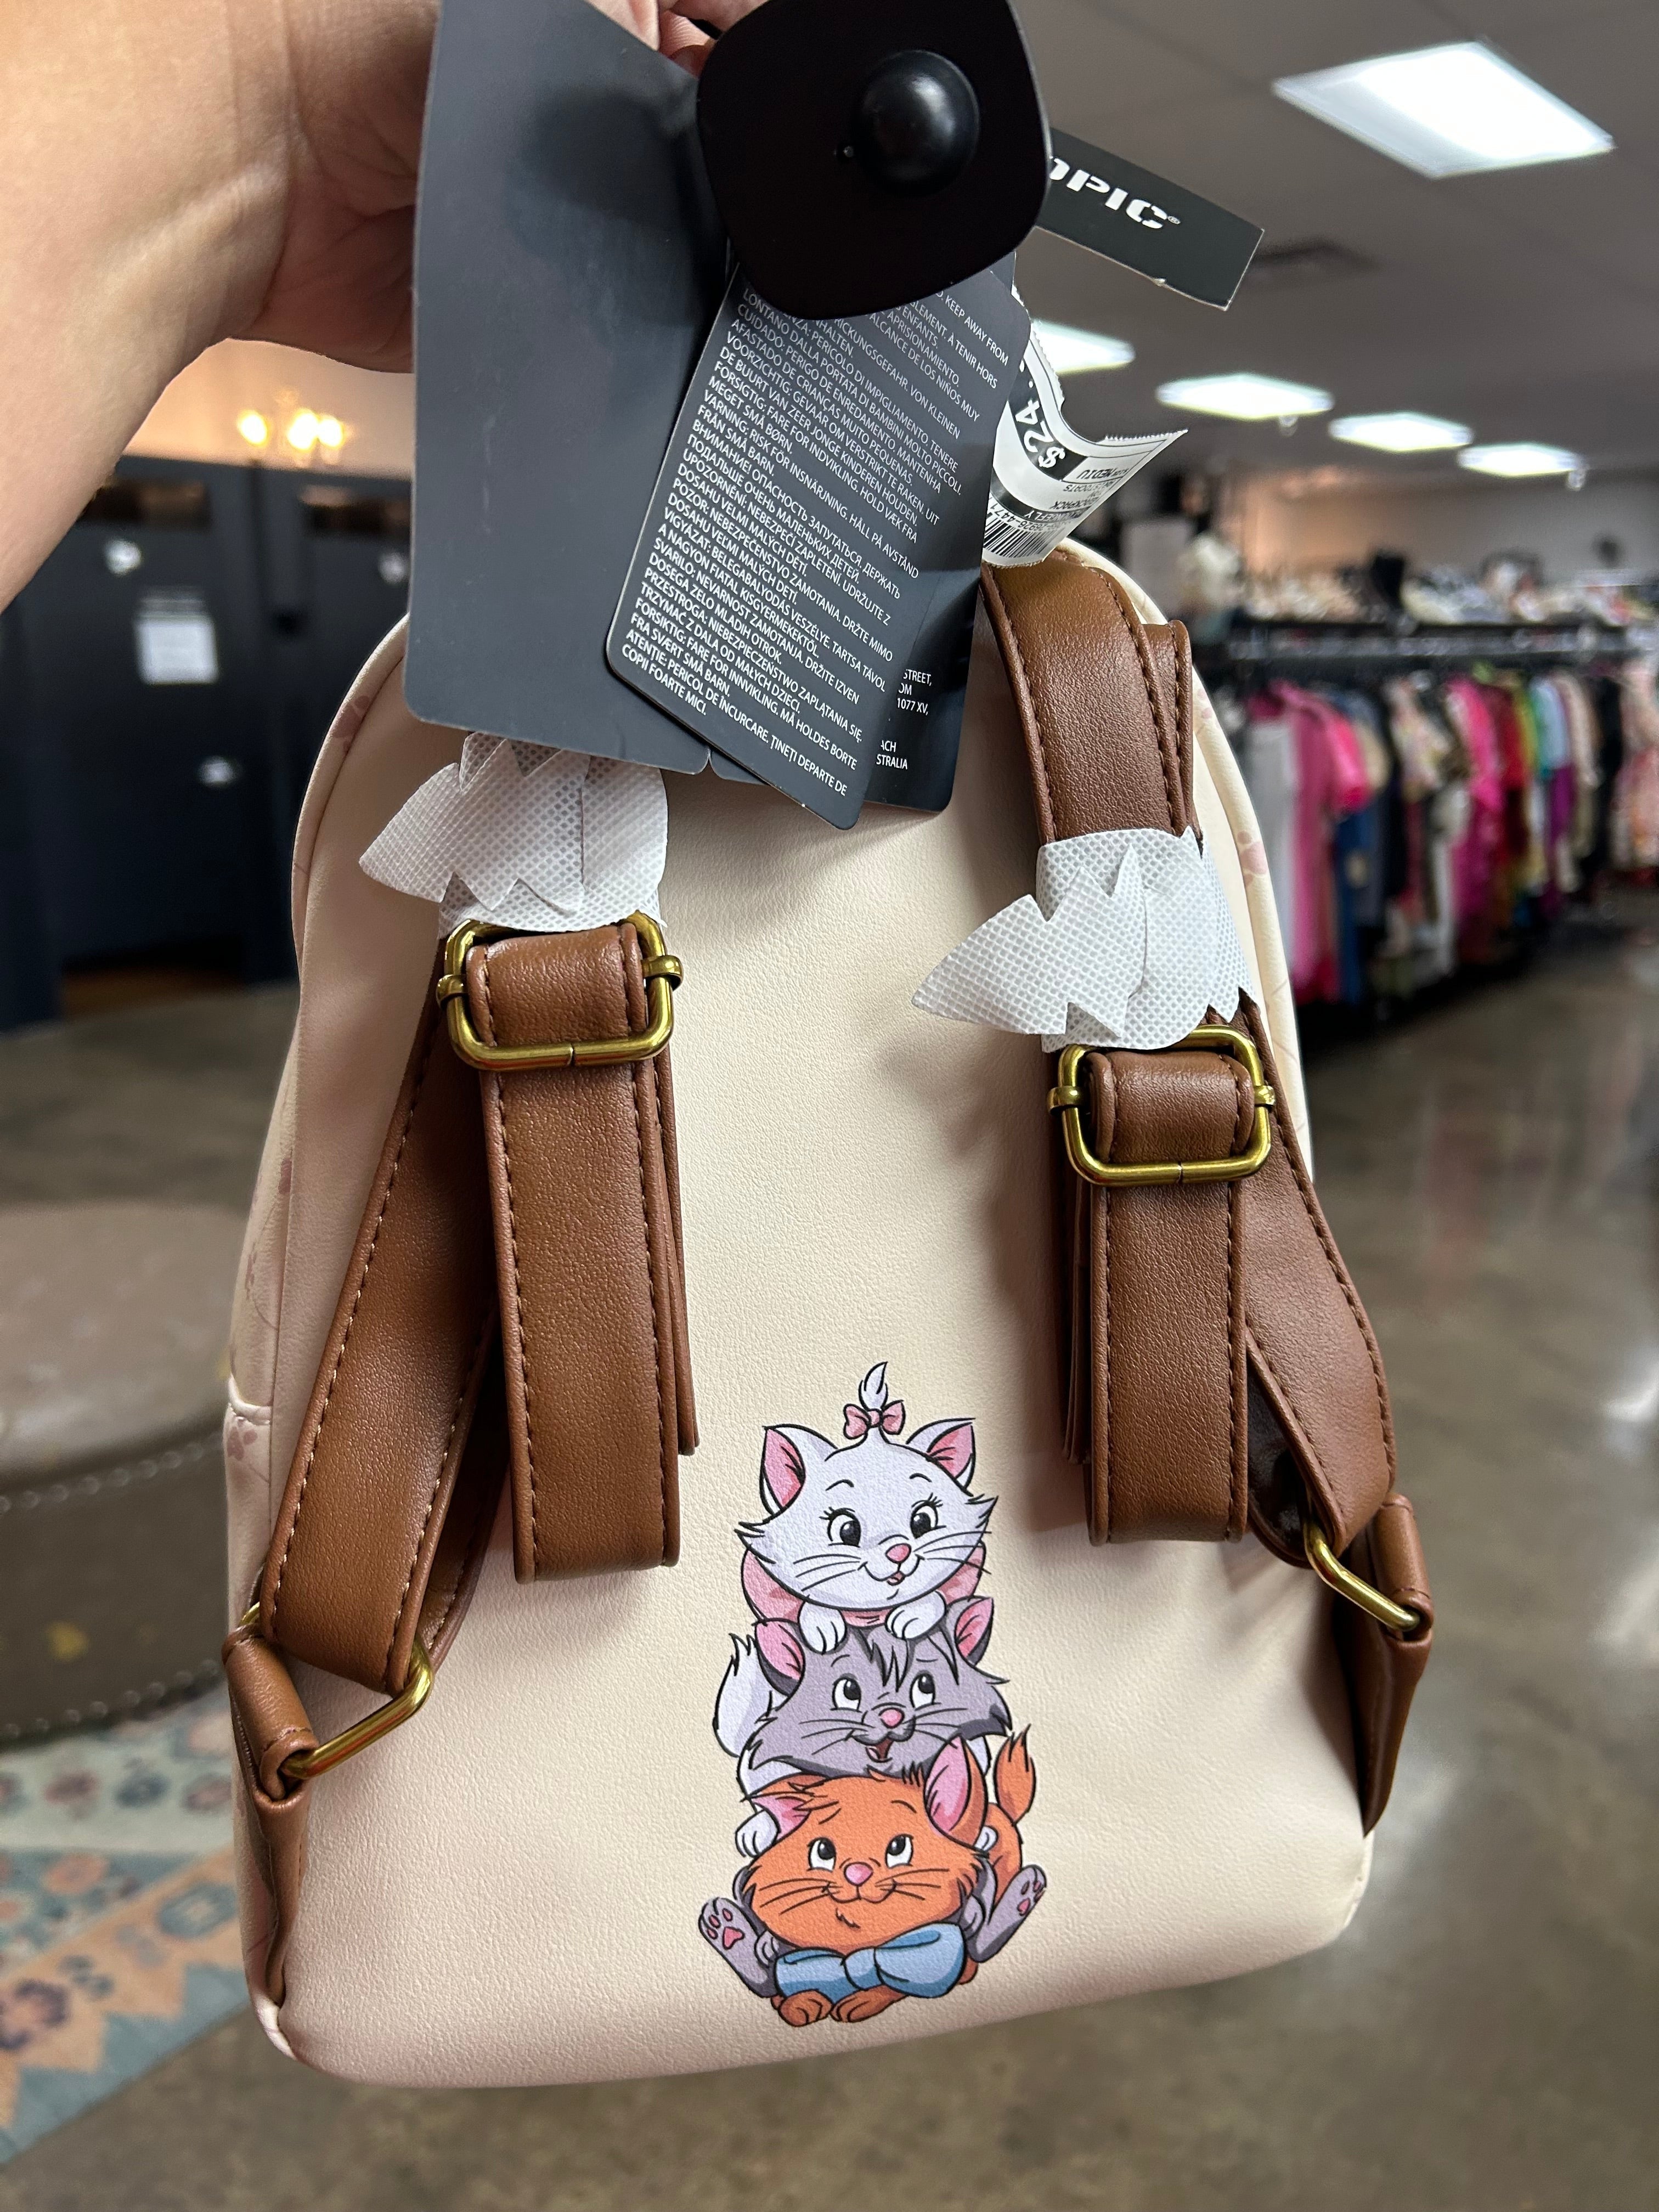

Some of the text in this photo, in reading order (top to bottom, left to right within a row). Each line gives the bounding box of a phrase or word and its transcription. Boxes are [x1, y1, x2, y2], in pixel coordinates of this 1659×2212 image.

[869, 312, 980, 422] ALCANCE DE LOS NIÑOS MUY
[887, 308, 960, 388] APRISIONAMIENTO.
[902, 305, 938, 349] ENFANTS.
[945, 294, 1009, 366] KEEP AWAY FROM
[947, 332, 998, 389] À TENIR HORS
[697, 404, 775, 477] FRÅN SMÅ BARN.
[708, 375, 793, 455] MEGET SMÅ BØRN.
[714, 360, 917, 544] FORSIGTIG: FARE FOR INDVIKLING. HOLD VÆK FRA
[719, 346, 918, 527] DE BUURT VAN ZEER JONGE KINDEREN HOUDEN.
[727, 330, 940, 526] VOORZICHTIG: GEVAAR OM VERSTRIKT TE RAKEN. UIT
[731, 319, 782, 366] AFASTADO
[782, 362, 797, 380] DE
[797, 375, 841, 419] CRIANÇAS
[840, 413, 870, 444] MUITO
[869, 439, 913, 487] PEQUENAS.
[737, 303, 786, 352] CUIDADO:
[785, 345, 819, 381] PERIGO
[819, 375, 833, 394] DE
[832, 387, 896, 453] ENREDAMENTO.
[896, 446, 941, 494] MANTENHA
[743, 288, 789, 335] LONTANO
[789, 330, 819, 364] DALLA
[820, 357, 857, 399] PORTATA
[858, 392, 870, 408] DI
[868, 402, 904, 440] BAMBINI
[903, 434, 932, 465] MOLTO
[932, 460, 962, 496] PICCOLI.
[811, 330, 958, 473] PERICOLO DI IMPIGLIAMENTO. TENERE
[910, 384, 929, 409] VON
[928, 402, 961, 439] KLEINEN
[1015, 360, 1065, 469] $24.
[668, 492, 712, 533] DOSAHU
[738, 550, 777, 587] MALÝCH
[776, 579, 798, 605] DETÍ.
[678, 462, 721, 504] DOSAHU
[721, 496, 749, 528] VELMI
[748, 521, 787, 558] MALÝCH
[687, 433, 860, 584] ПОДАЛЬШЕ ОЧЕНЬ МАЛЕНЬКИХ ДЕТЕЙ.
[692, 419, 900, 599] ВНИМАНИЕ! ОПАСНОСТЬ ЗАПУТАТЬСЯ. ДЕРЖАТЬ
[704, 389, 919, 579] VARNING: RISK FÖR INSNÄRJNING. HÅLL PÅ AVSTÅND
[648, 551, 782, 665] DOSEGA ZELO MLADIH OTROK.
[653, 537, 860, 705] SVARILO: NEVARNOST ZAMOTANJA. DRŽITE IZVEN
[657, 523, 667, 537] A
[667, 529, 710, 570] NAGYON
[709, 562, 738, 595] FIATAL
[664, 506, 712, 554] VIGYÁZAT:
[791, 608, 831, 650] VESZÉLYE.
[832, 640, 861, 673] TARTSA
[862, 664, 885, 692] TÁVOL
[672, 477, 709, 515] POZOR:
[789, 572, 841, 623] ZAMOTANIA.
[842, 615, 870, 644] DRŽTE
[868, 636, 893, 662] MIMO
[747, 501, 797, 548] NEBEZPEČÍ
[794, 540, 842, 587] ZAPLETENÍ.
[842, 579, 884, 621] UDRŽUJTE
[883, 613, 891, 627] Z
[622, 644, 707, 716] COPII FOARTE MICI.
[630, 612, 730, 697] FRA SVÆRT SMÅ BARN.
[635, 597, 687, 645] FORSIKTIG:
[686, 636, 710, 662] FARE
[709, 654, 729, 677] FOR
[728, 669, 778, 716] INNVIKLING.
[780, 708, 795, 727] MÅ
[795, 719, 831, 751] HOLDES
[830, 743, 857, 771] BORTE
[641, 581, 800, 714] TRZYMAĆ Z DALA OD MAŁYCH DZIECI.
[644, 567, 708, 624] PRZESTROGA:
[798, 686, 848, 731] ZAPLĄTANIA
[849, 724, 862, 743] SIĘ.
[897, 697, 929, 715] 1077 XV,
[667, 658, 848, 797] PERICOL DE ÎNCURCARE. DEPARTE DE
